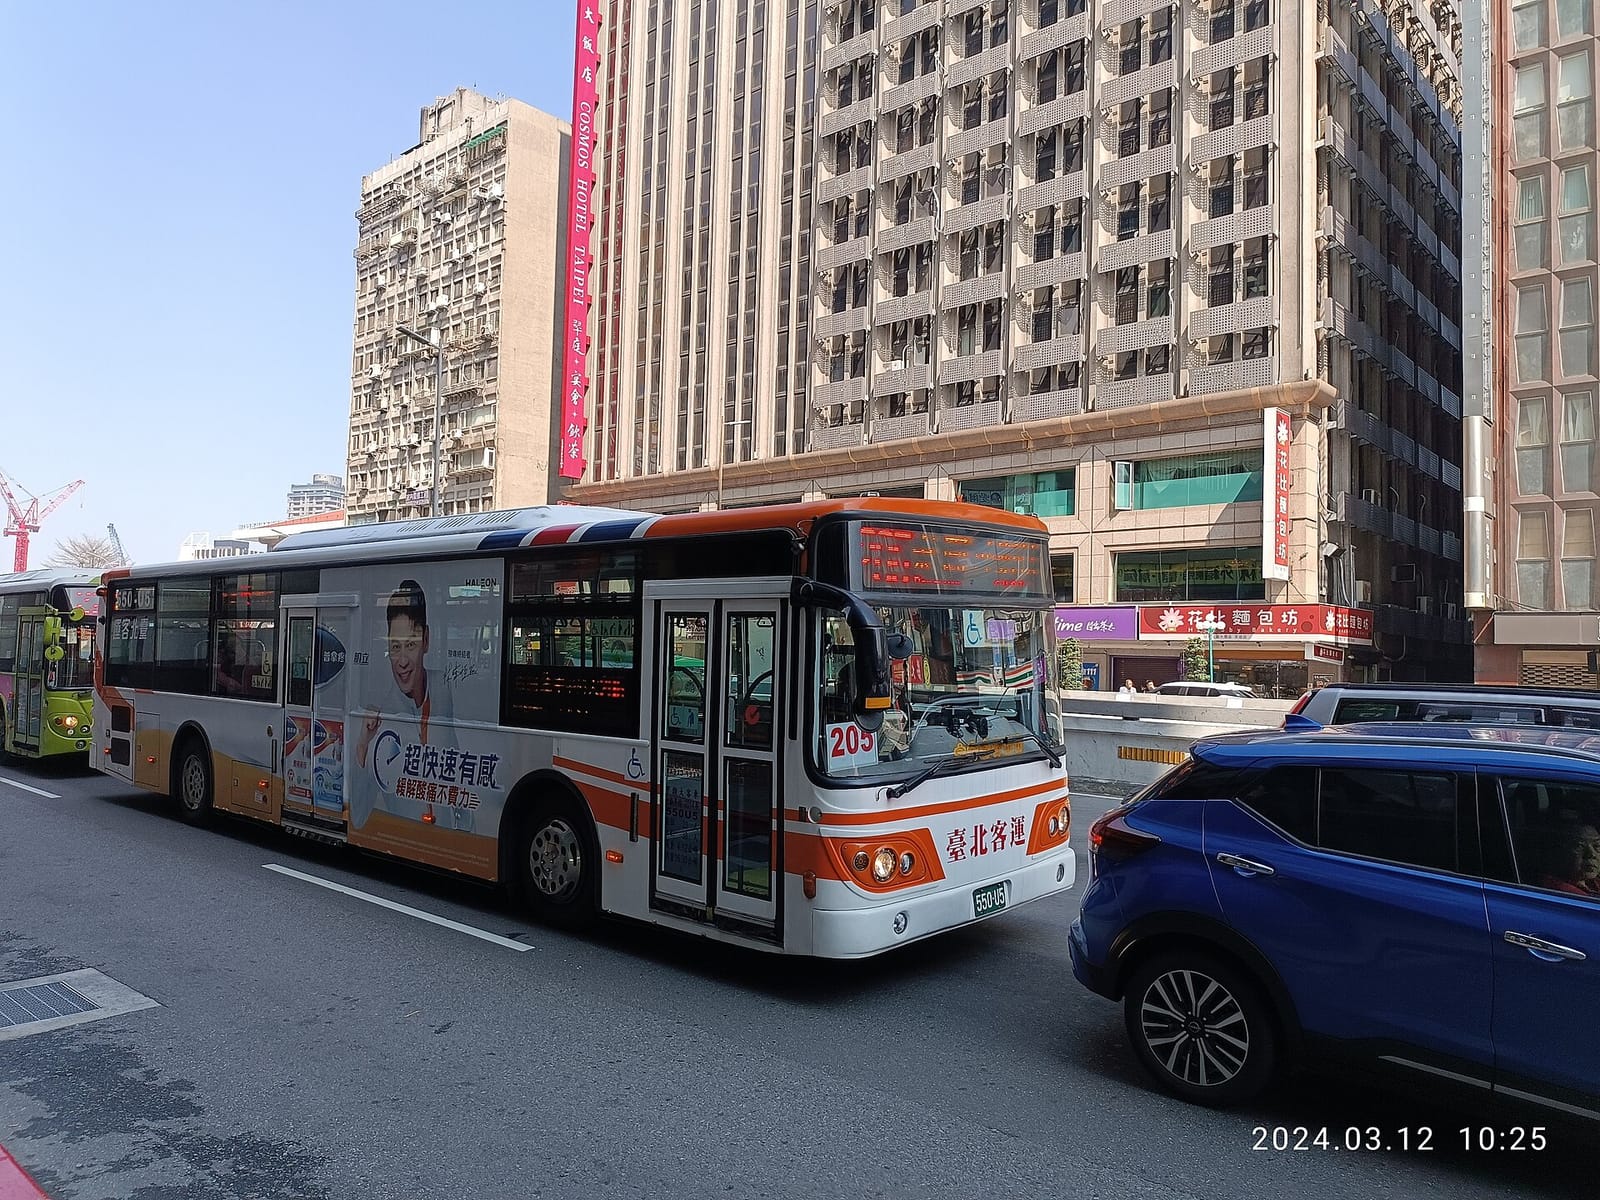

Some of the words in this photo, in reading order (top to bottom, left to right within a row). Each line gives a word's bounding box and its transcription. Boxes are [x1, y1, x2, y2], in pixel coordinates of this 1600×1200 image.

[581, 5, 595, 83] 大飯店
[577, 101, 591, 170] COSMOS
[575, 178, 588, 233] HOTEL
[573, 245, 585, 305] TAIPEI
[465, 578, 497, 588] HALEON
[830, 725, 873, 757] 205
[402, 743, 500, 789] 超快速有感
[395, 776, 469, 809] 緩解酸痛不費力
[946, 815, 1026, 864] 臺北客運
[975, 889, 1005, 912] 550-U5
